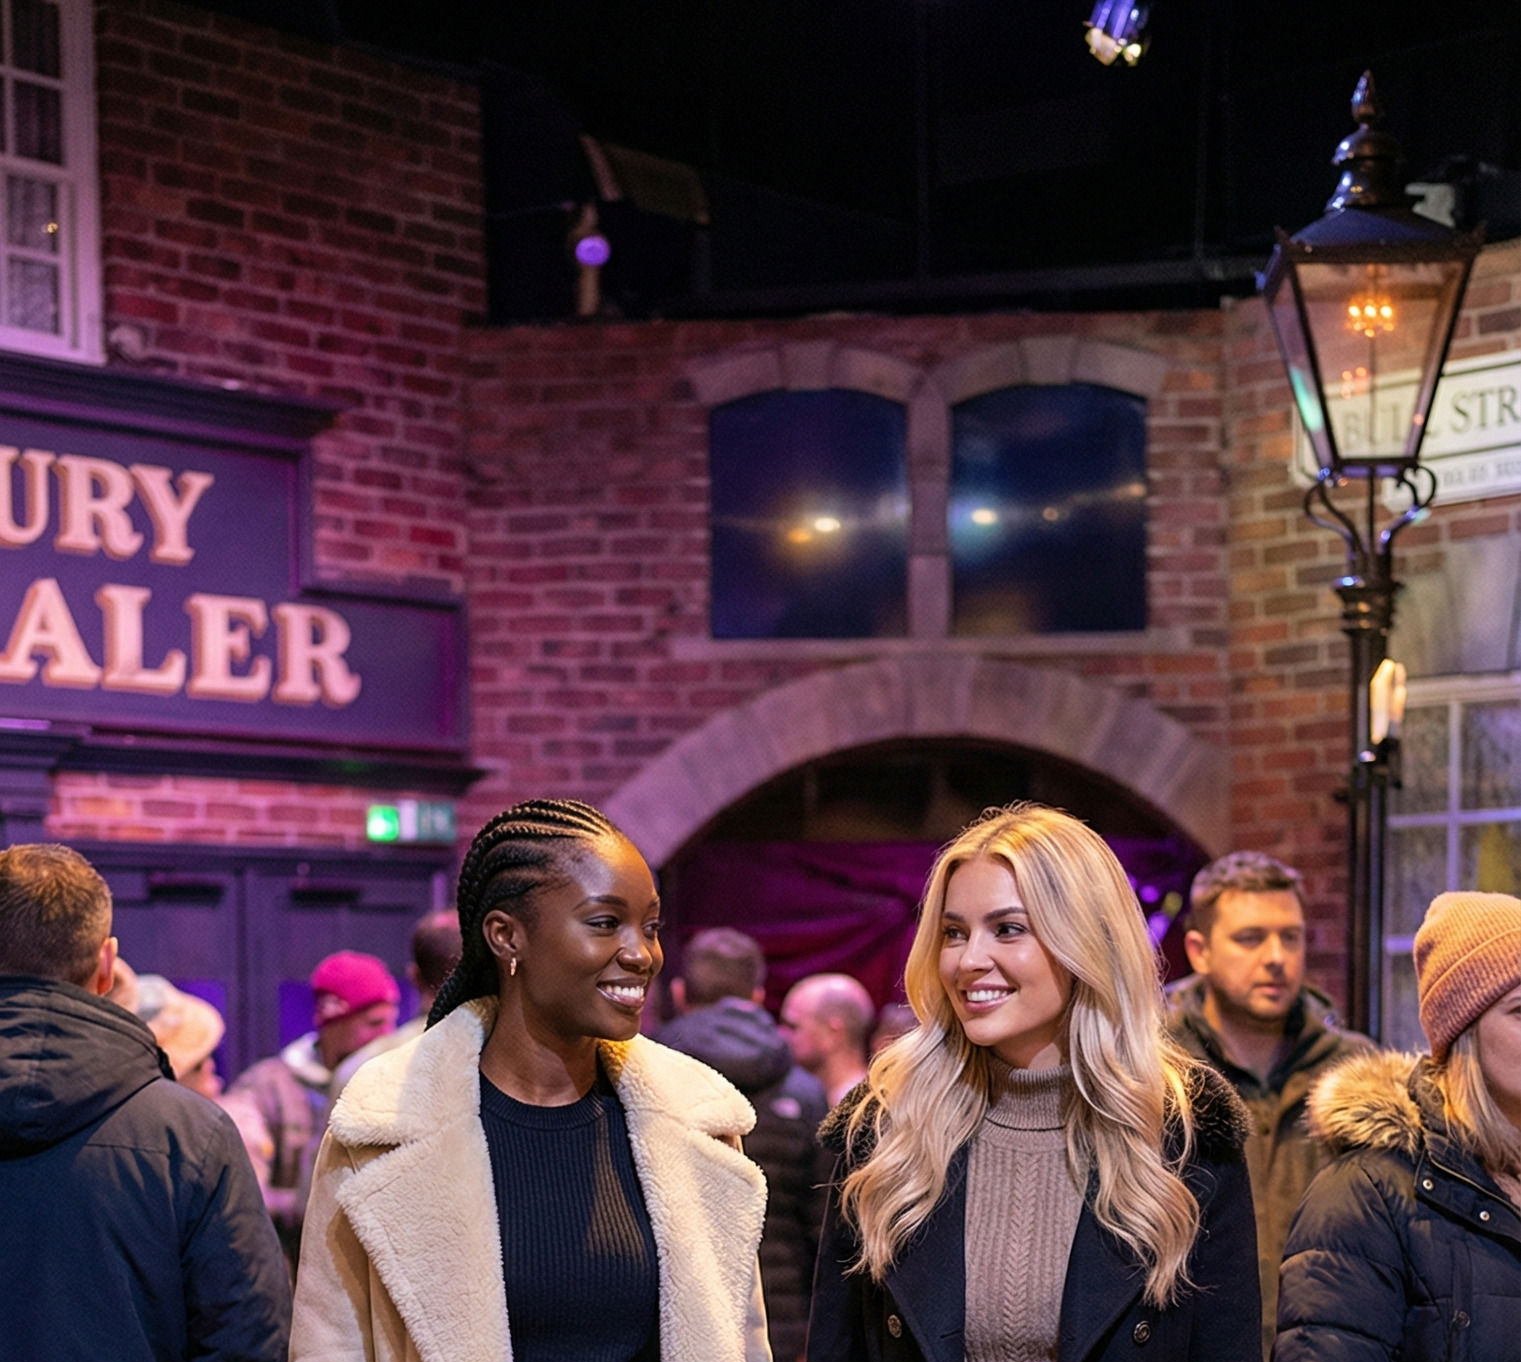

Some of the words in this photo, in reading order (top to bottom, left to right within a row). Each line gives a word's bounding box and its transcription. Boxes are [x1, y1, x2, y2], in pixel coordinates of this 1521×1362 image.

[1451, 384, 1521, 434] STR
[0, 444, 214, 566] URY
[0, 578, 361, 709] ALER
